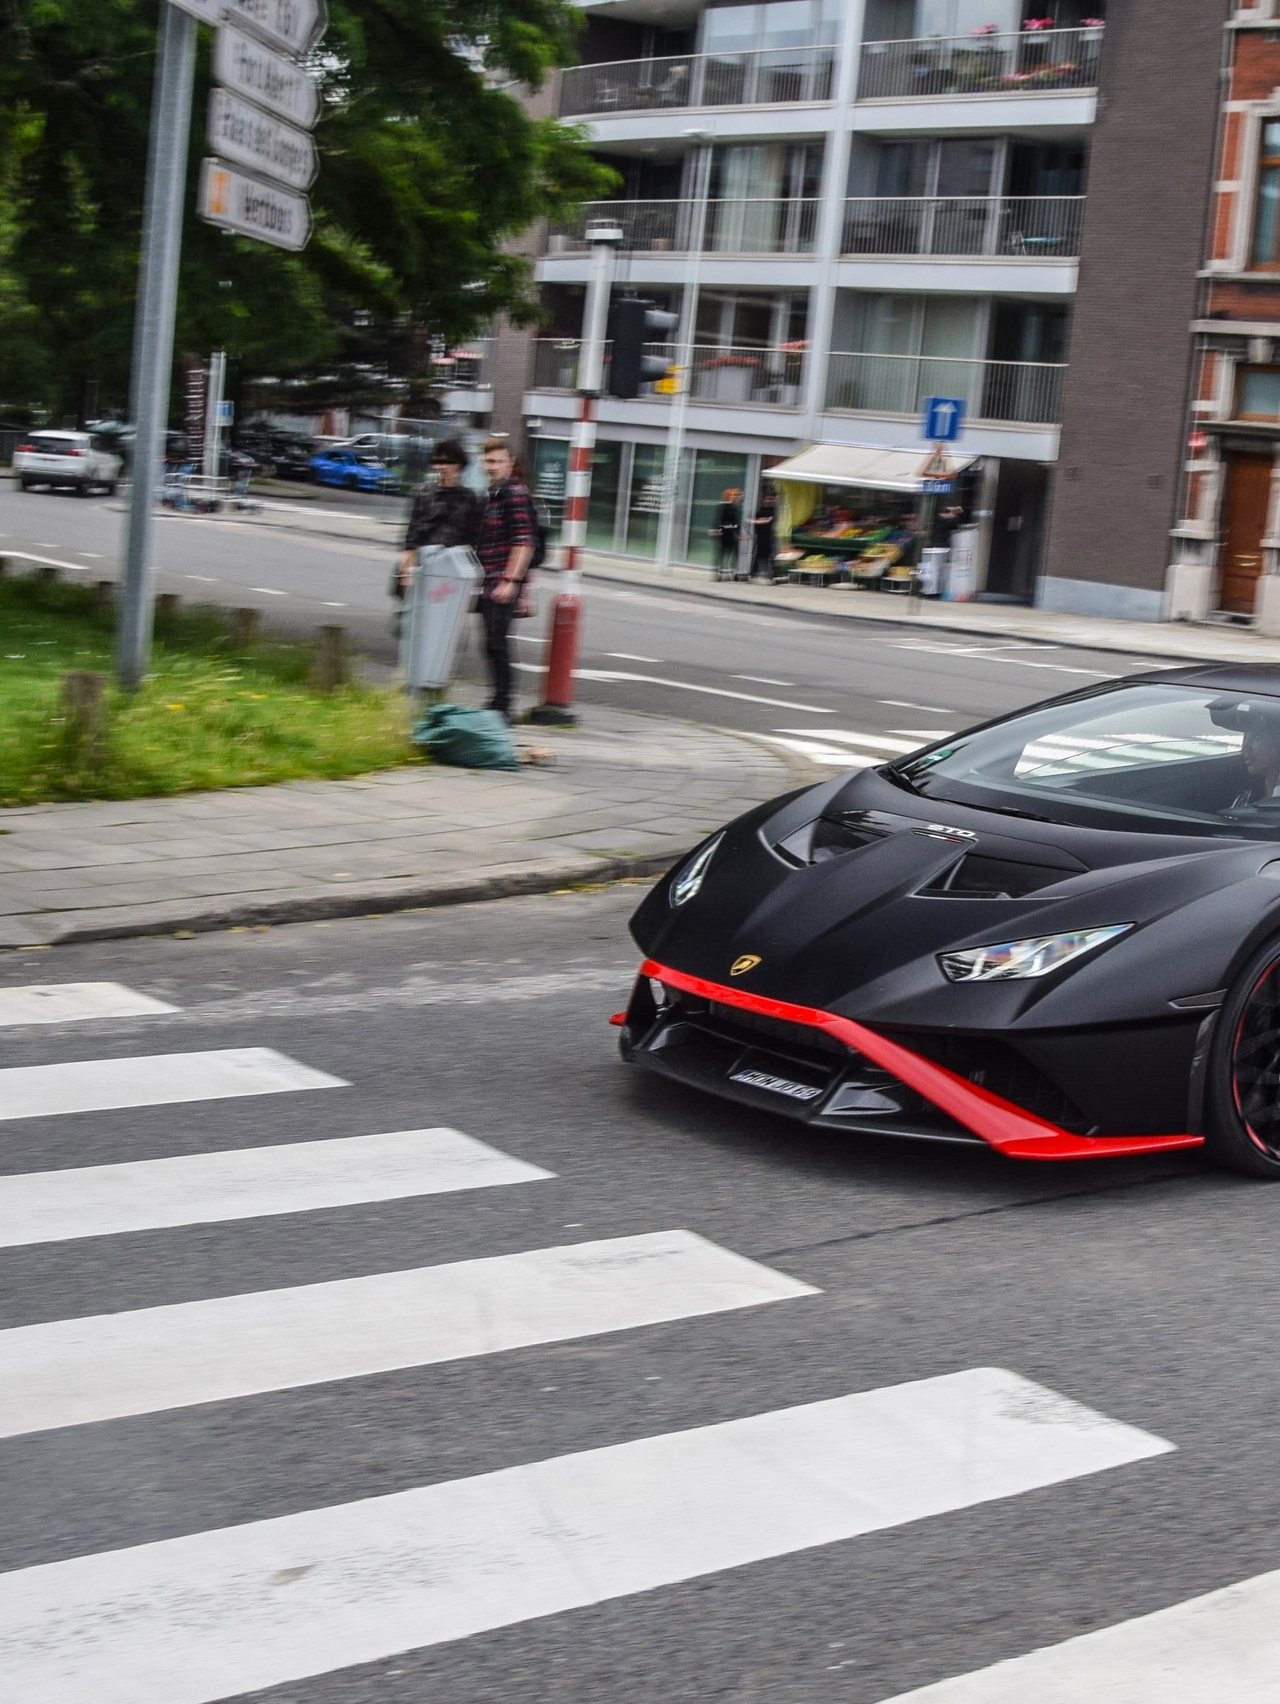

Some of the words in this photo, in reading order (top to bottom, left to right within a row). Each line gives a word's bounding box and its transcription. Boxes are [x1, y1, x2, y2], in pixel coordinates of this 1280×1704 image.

[927, 824, 977, 837] STO
[743, 1073, 778, 1086] MON
[792, 1086, 818, 1097] 69
